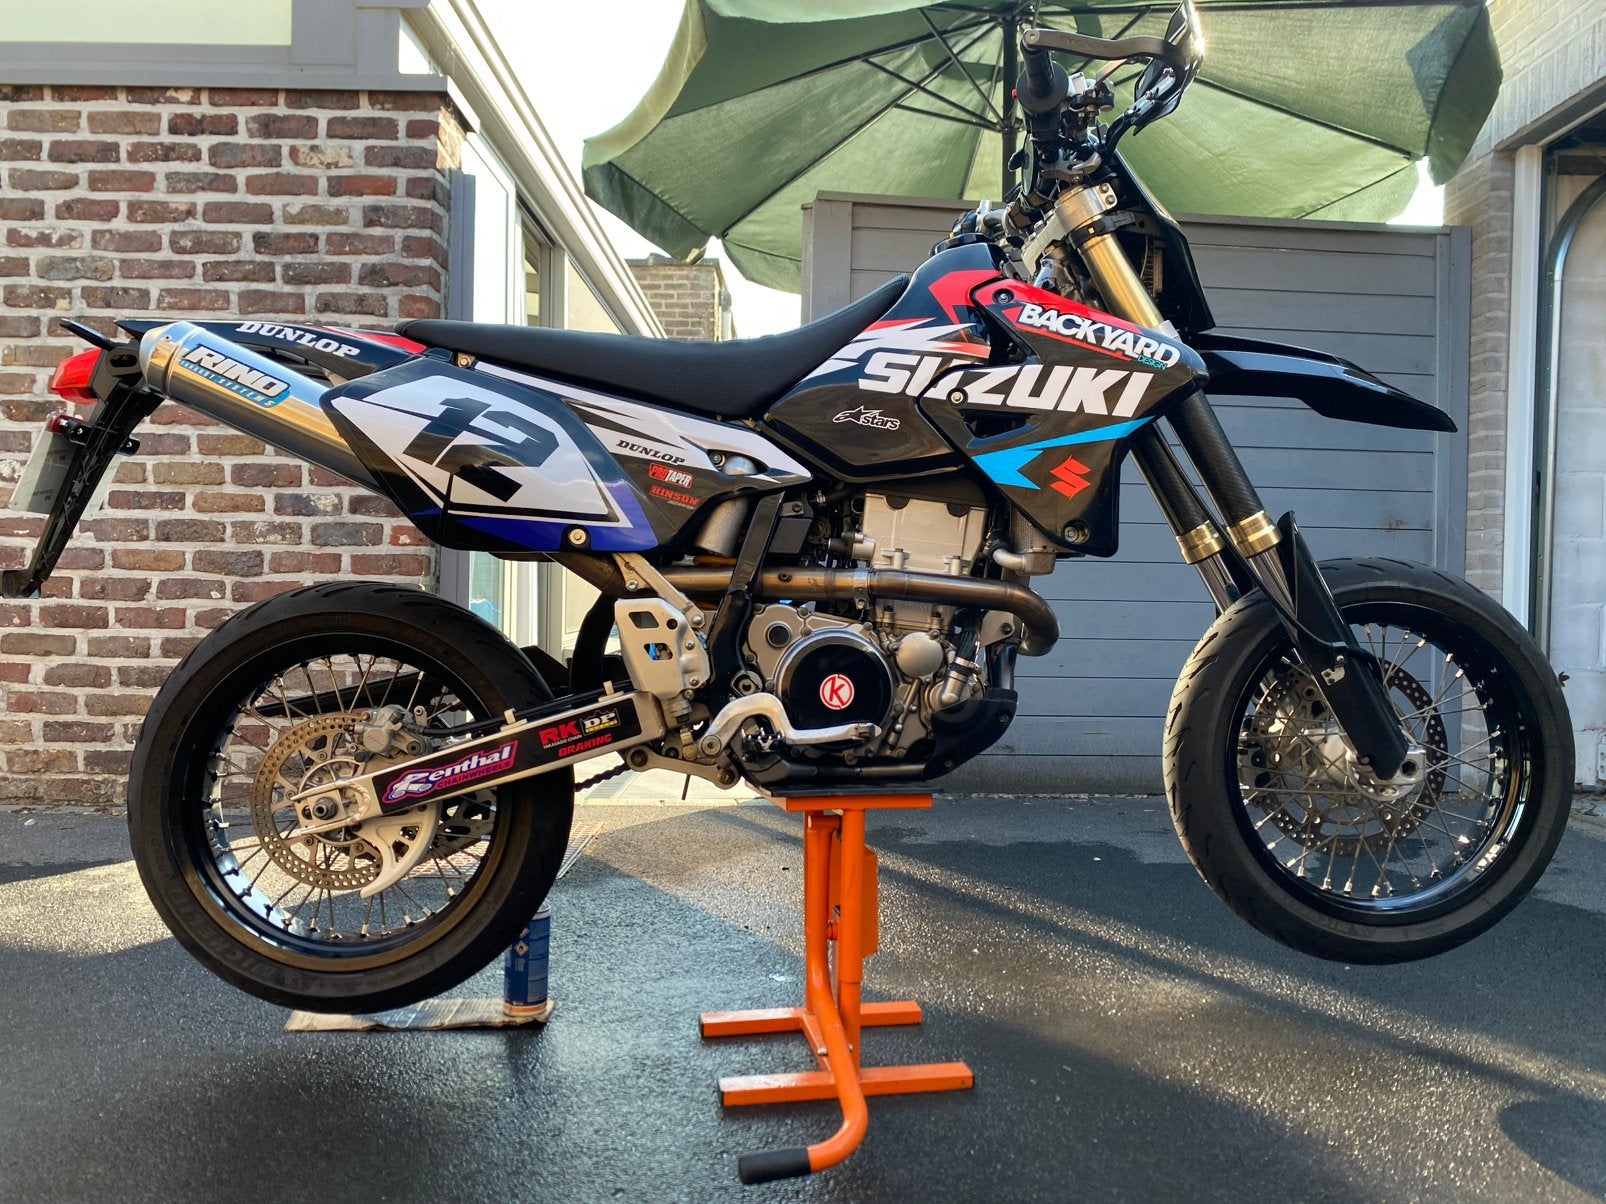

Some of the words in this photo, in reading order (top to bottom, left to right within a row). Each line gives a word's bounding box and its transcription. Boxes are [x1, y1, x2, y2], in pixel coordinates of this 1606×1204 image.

[235, 321, 361, 358] DUNLOP
[1018, 302, 1180, 368] BACKYARD
[184, 346, 289, 397] RINO
[1137, 354, 1168, 371] DESIGN
[858, 352, 1154, 418] SUZUKI
[860, 412, 900, 430] stars
[403, 397, 560, 503] 12
[616, 439, 686, 464] DUNLOP
[650, 486, 698, 507] HINSON
[539, 720, 580, 745] RK
[558, 733, 612, 757] BRAKING
[437, 761, 511, 789] CHAINWHEELS
